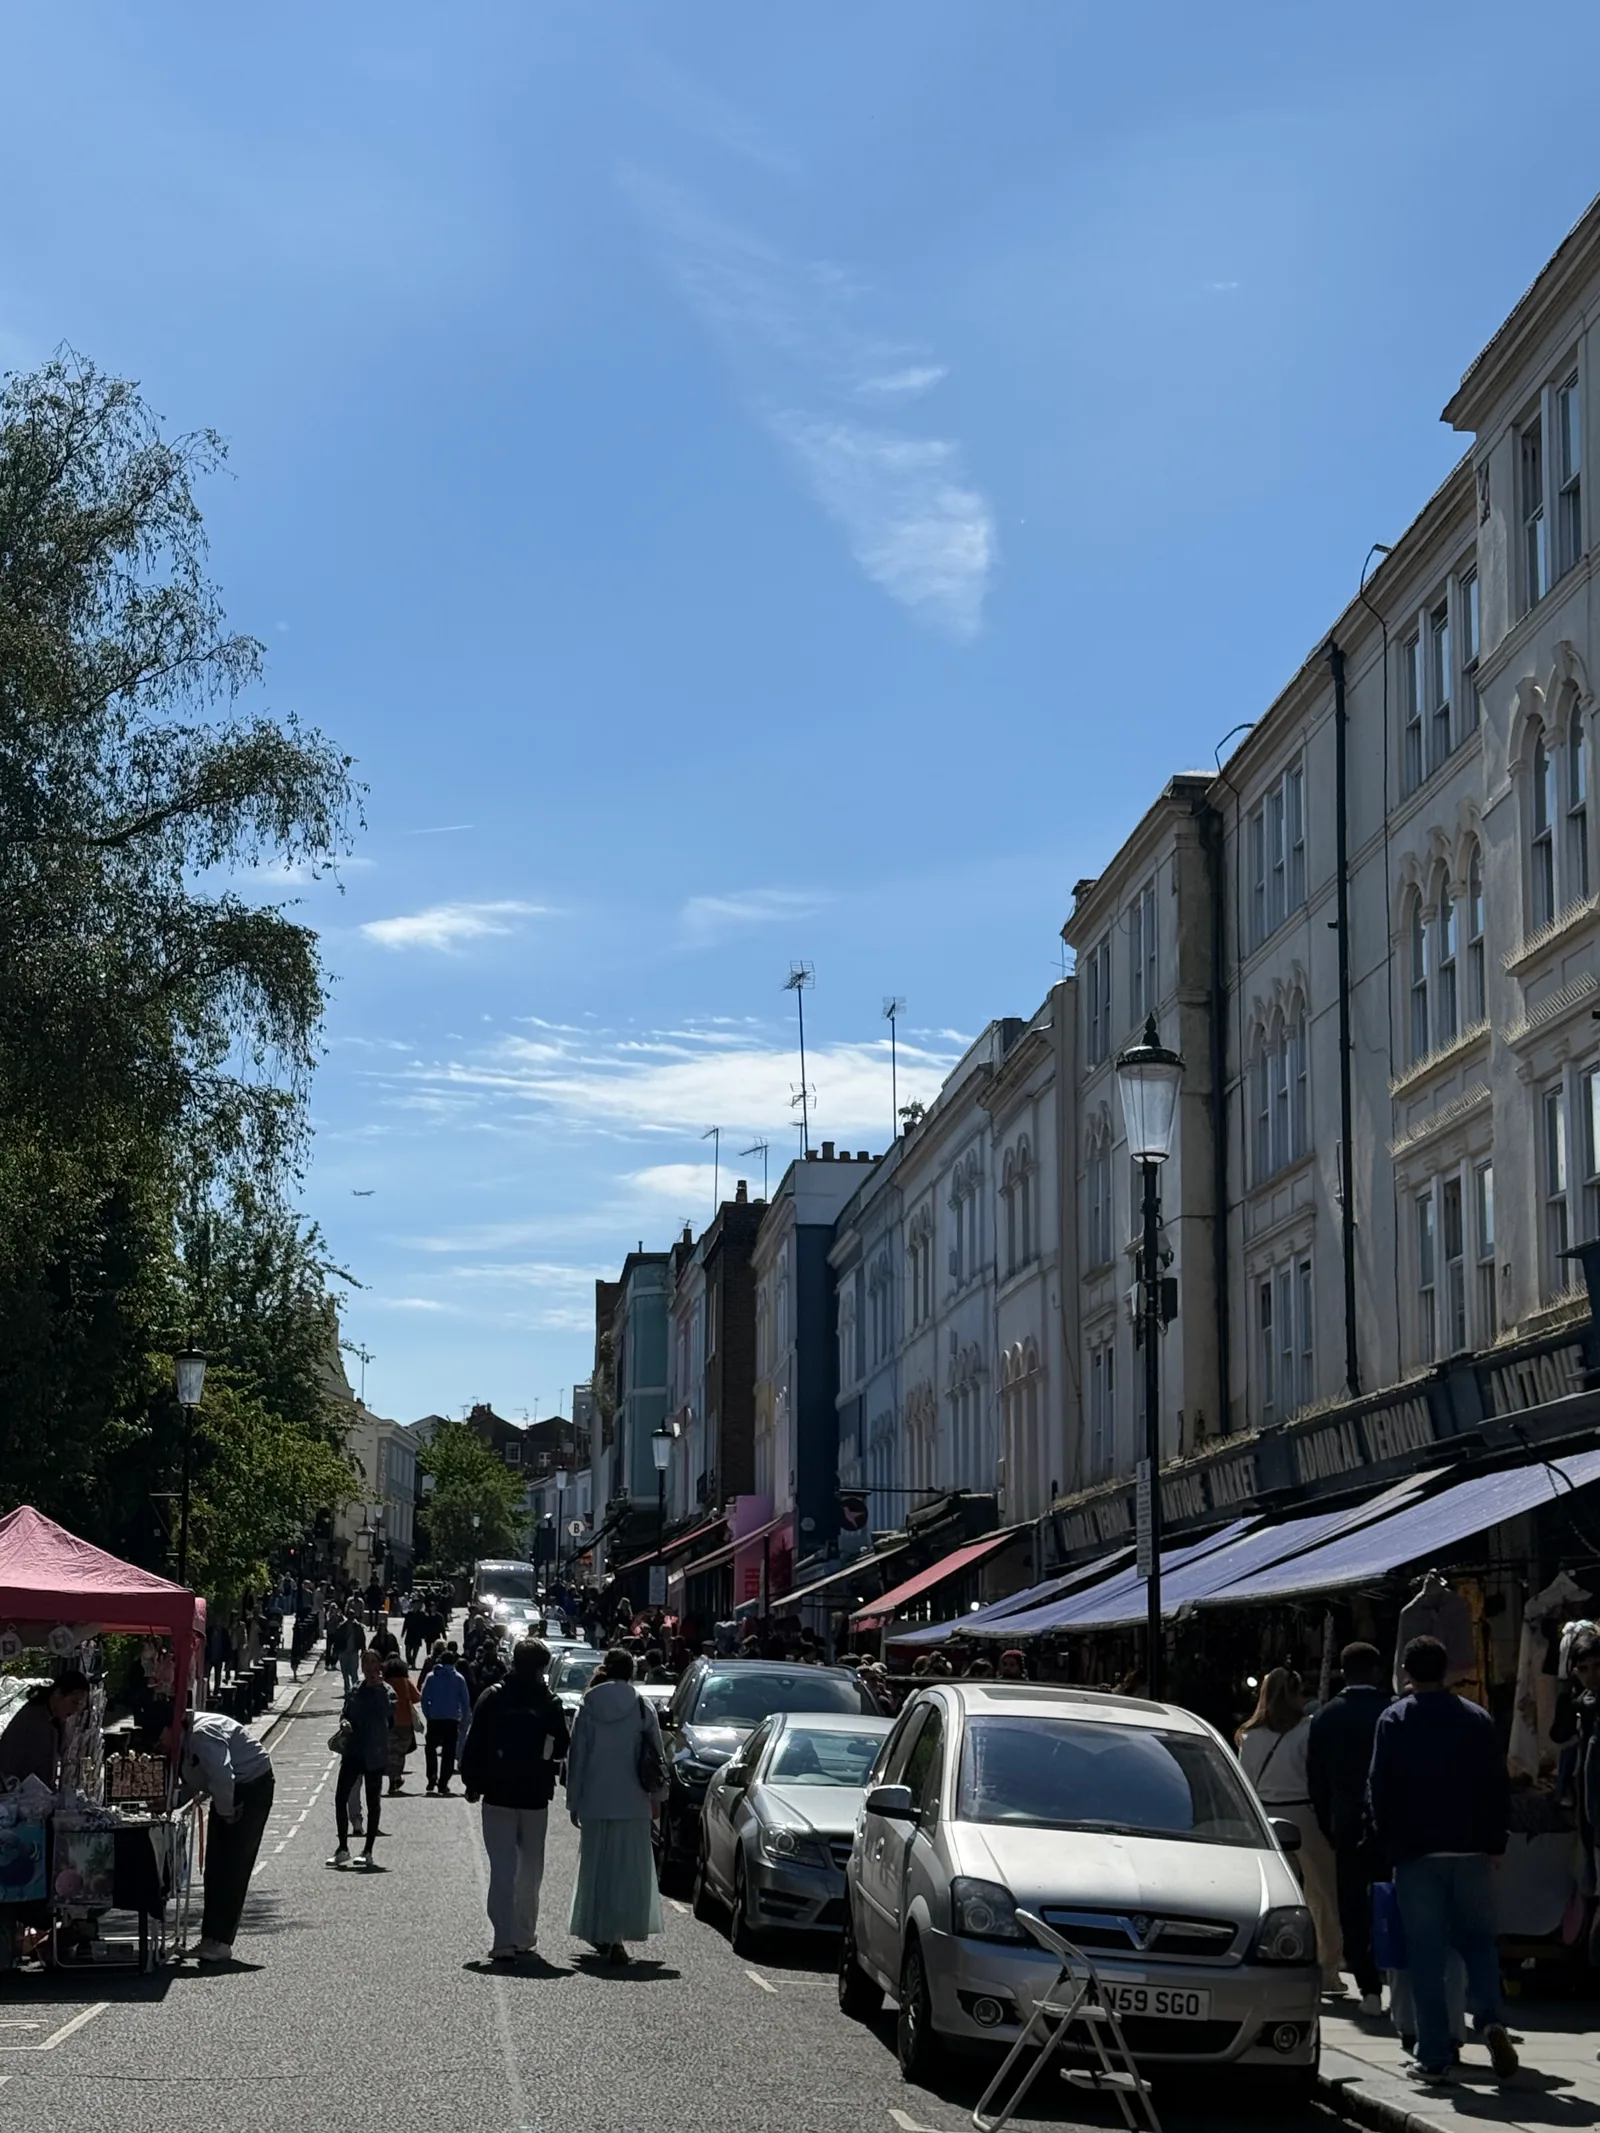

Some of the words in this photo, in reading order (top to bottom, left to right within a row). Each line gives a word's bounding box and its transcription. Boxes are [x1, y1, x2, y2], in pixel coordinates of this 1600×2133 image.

[1490, 1344, 1587, 1416] ANTIQUE
[1296, 1420, 1365, 1484] ADMIRAL
[1361, 1395, 1436, 1463] VERNON
[1161, 1473, 1208, 1523] ANTIQUE
[1209, 1454, 1258, 1509] MARKET
[573, 1523, 580, 1533] B
[1156, 1991, 1199, 2016] SGO
